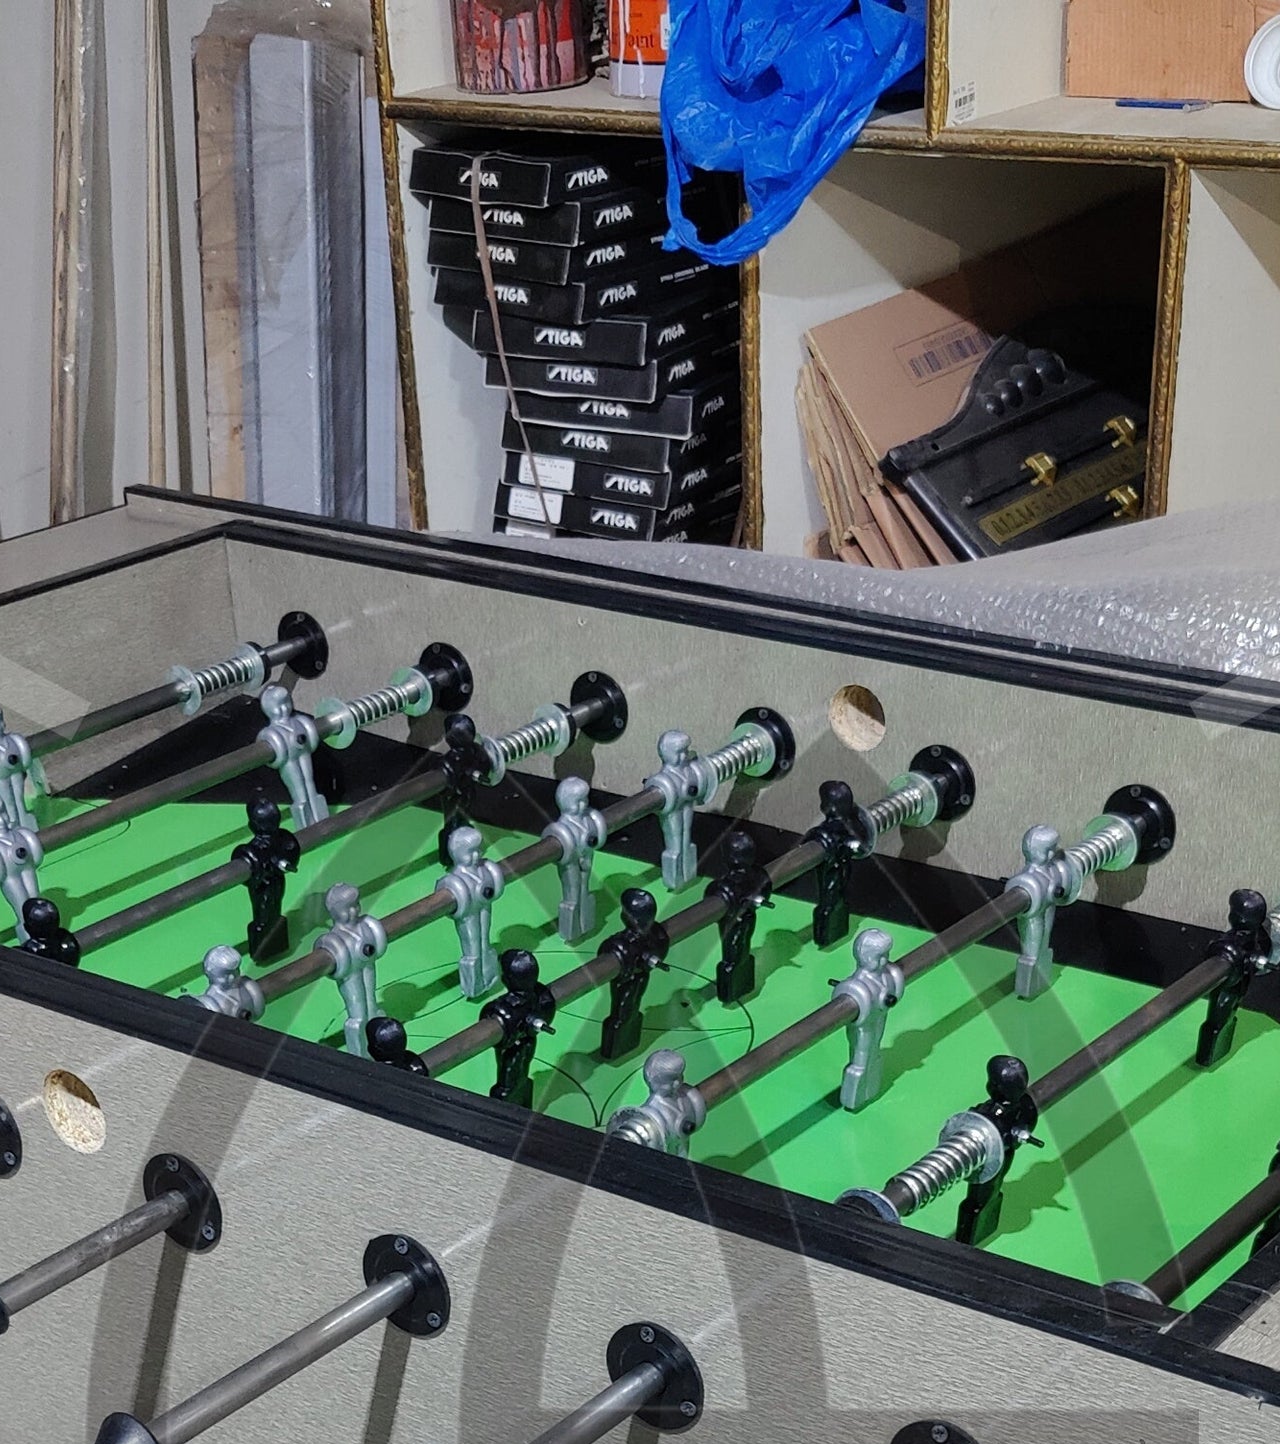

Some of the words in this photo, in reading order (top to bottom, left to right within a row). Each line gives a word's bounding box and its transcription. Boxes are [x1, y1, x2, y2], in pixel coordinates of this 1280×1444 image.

[568, 167, 608, 189] STIGA
[596, 204, 633, 227] STIGA
[586, 245, 625, 267] STIGA
[600, 284, 636, 306] STIGA
[535, 328, 583, 347] STIGA
[658, 324, 685, 346] STIGA
[548, 366, 596, 385] STIGA
[669, 360, 695, 382] STIGA
[579, 401, 629, 418] STIGA
[702, 396, 724, 418] STIGA
[562, 433, 608, 452] STIGA
[681, 434, 707, 454] STIGA
[605, 476, 652, 496] STIGA
[681, 468, 708, 490] STIGA
[591, 511, 637, 531] STIGA
[665, 503, 694, 524] STIGA
